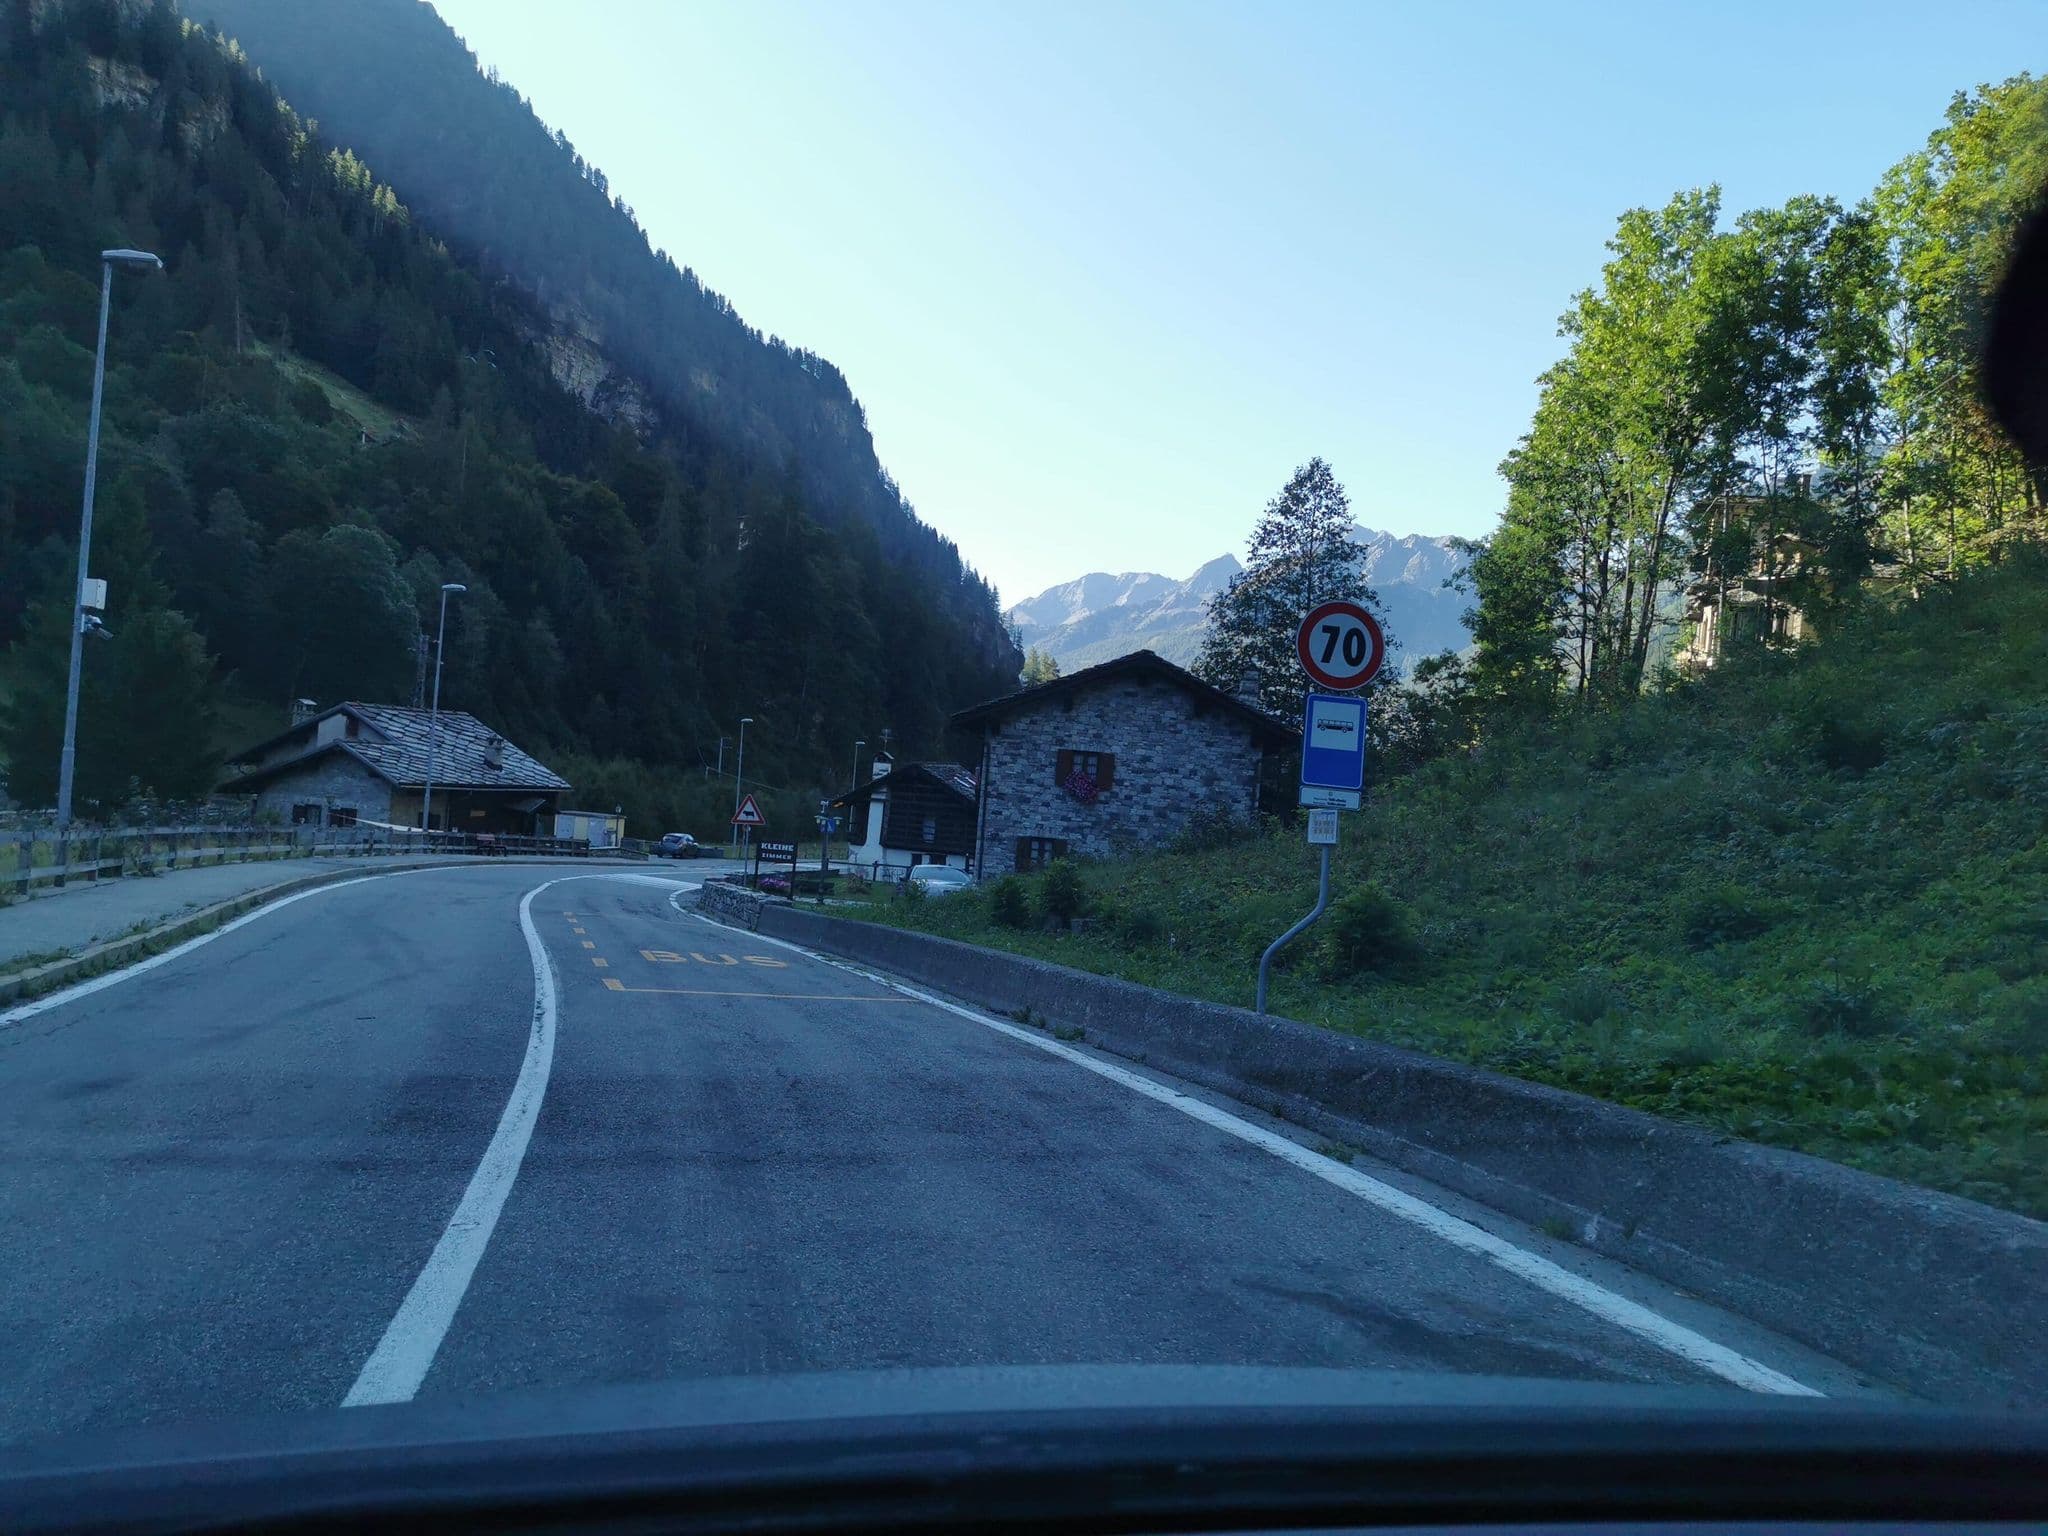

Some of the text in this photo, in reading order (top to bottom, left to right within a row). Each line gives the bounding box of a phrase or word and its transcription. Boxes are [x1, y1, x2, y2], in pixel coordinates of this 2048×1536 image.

[1321, 625, 1366, 667] 70
[761, 842, 794, 852] KLEINE
[638, 949, 788, 969] BUS
